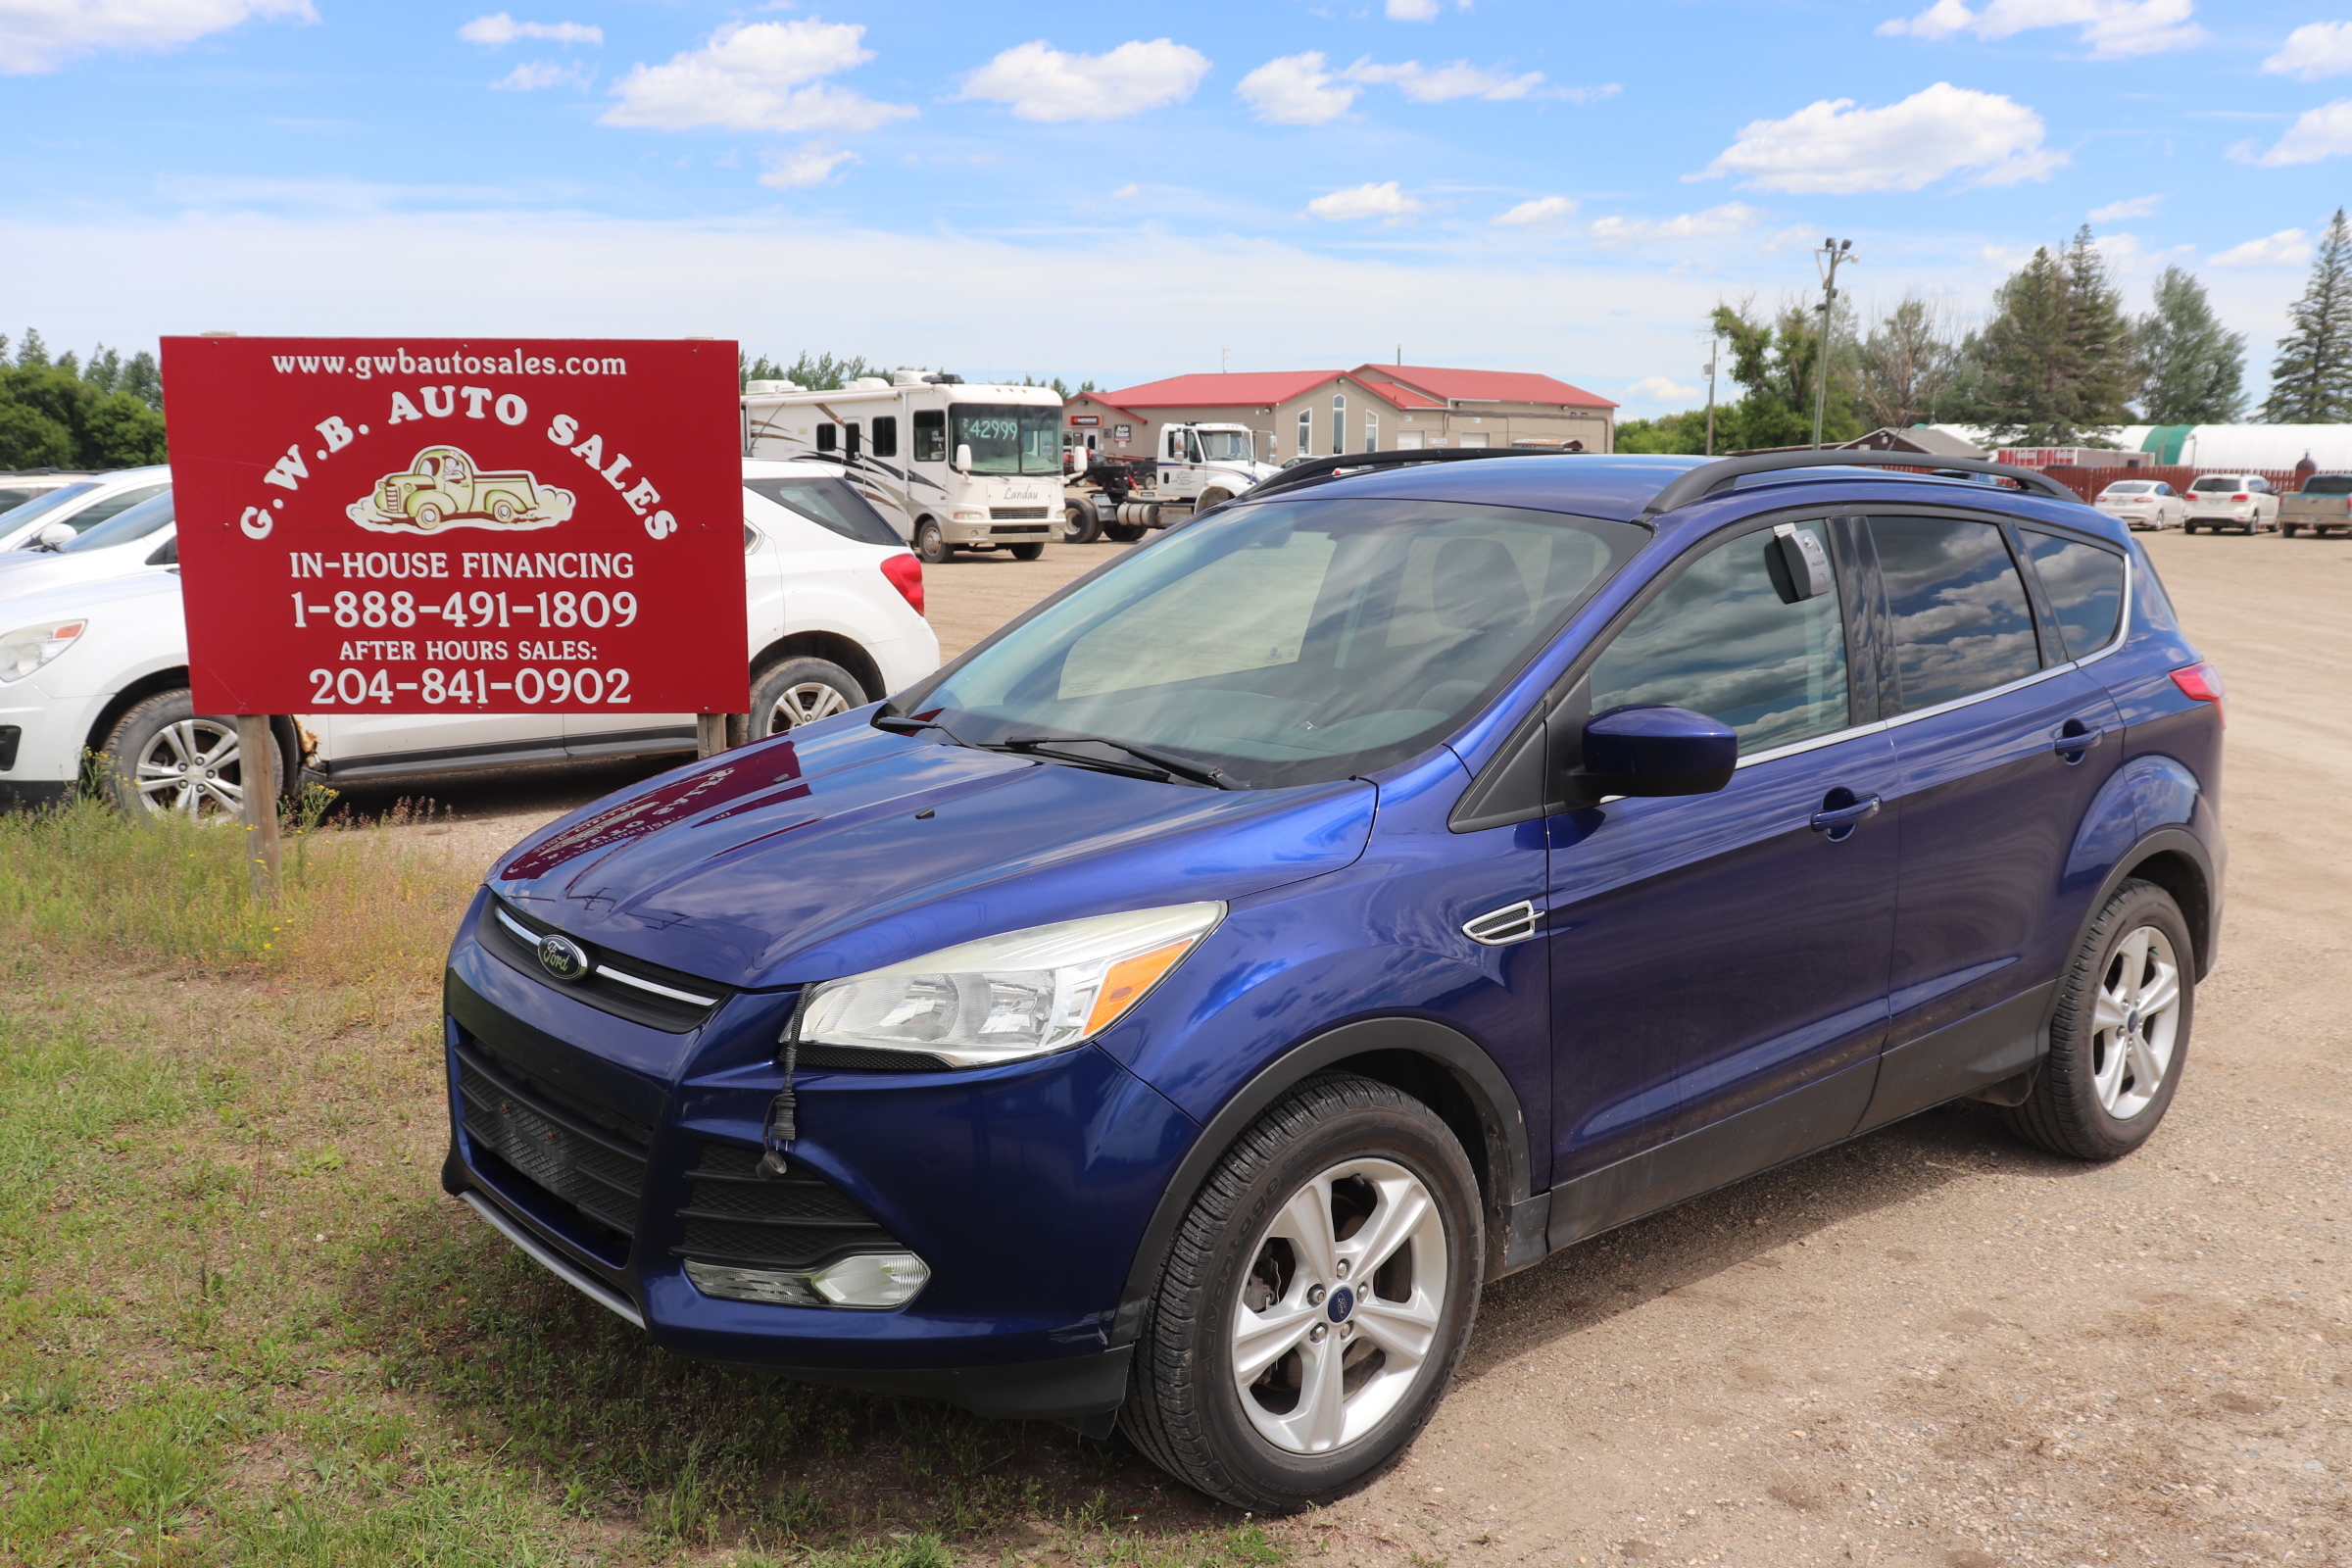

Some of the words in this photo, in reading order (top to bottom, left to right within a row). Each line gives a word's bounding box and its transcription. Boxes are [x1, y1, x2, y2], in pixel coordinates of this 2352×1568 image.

[271, 346, 627, 378] www.gwbautosales.com
[239, 416, 369, 540] G.W.B.
[387, 384, 528, 425] AUTO
[547, 414, 678, 541] SALES
[1003, 484, 1038, 500] Landau
[289, 552, 449, 578] IN-HOUSE
[461, 552, 634, 579] FINANCING
[290, 590, 638, 628] 1-888-491-1809
[338, 640, 416, 662] AFTER
[425, 640, 509, 662] HOURS
[517, 640, 598, 662] SALES:
[309, 667, 631, 706] 204-841-0902
[543, 940, 571, 972] Ford
